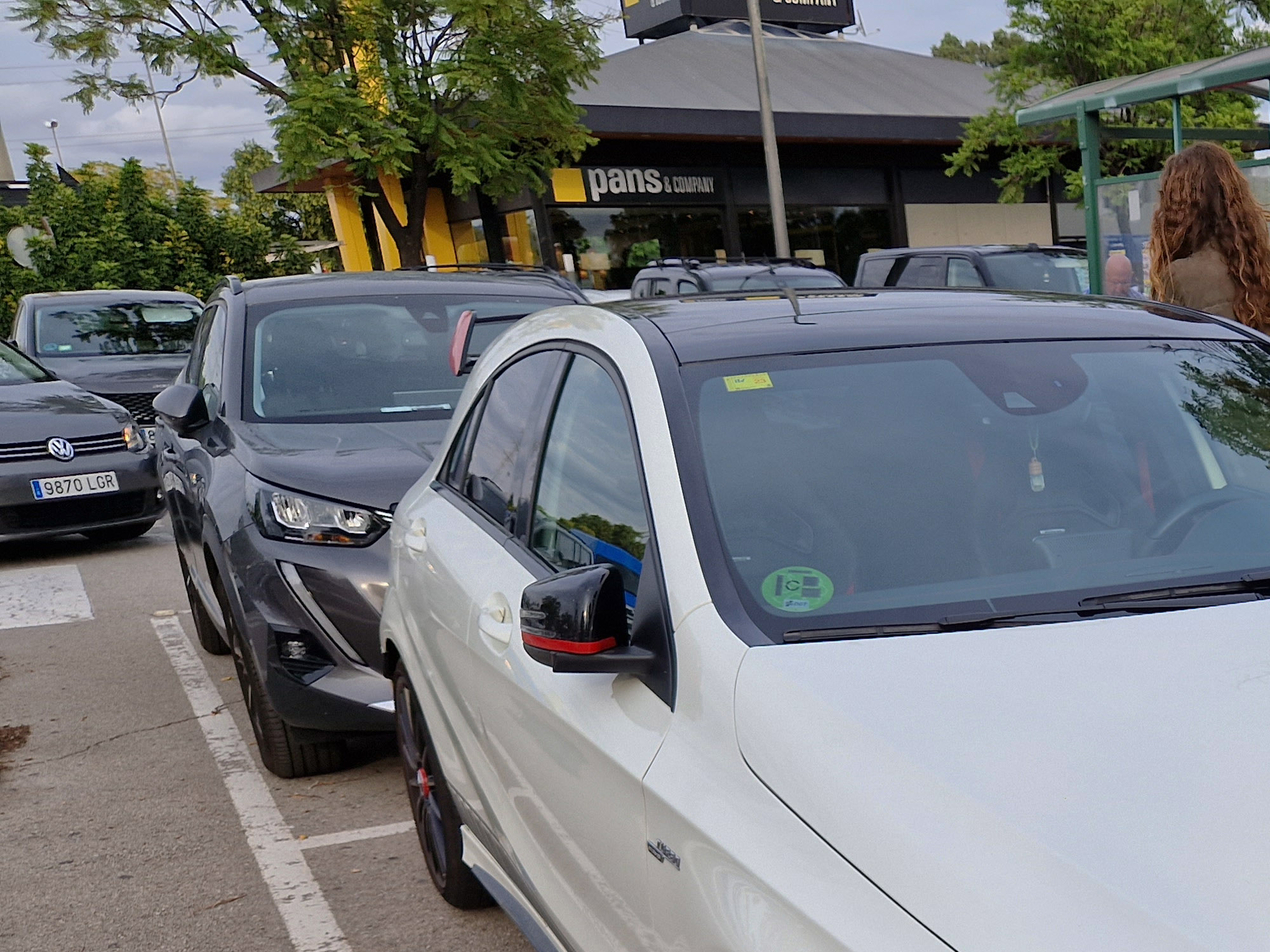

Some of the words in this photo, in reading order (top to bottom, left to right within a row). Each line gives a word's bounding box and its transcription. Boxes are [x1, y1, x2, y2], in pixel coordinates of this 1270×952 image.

[587, 168, 663, 202] pans
[663, 176, 672, 195] &
[673, 176, 715, 194] COMPANY
[44, 478, 83, 496] 9870
[86, 474, 116, 491] LGR
